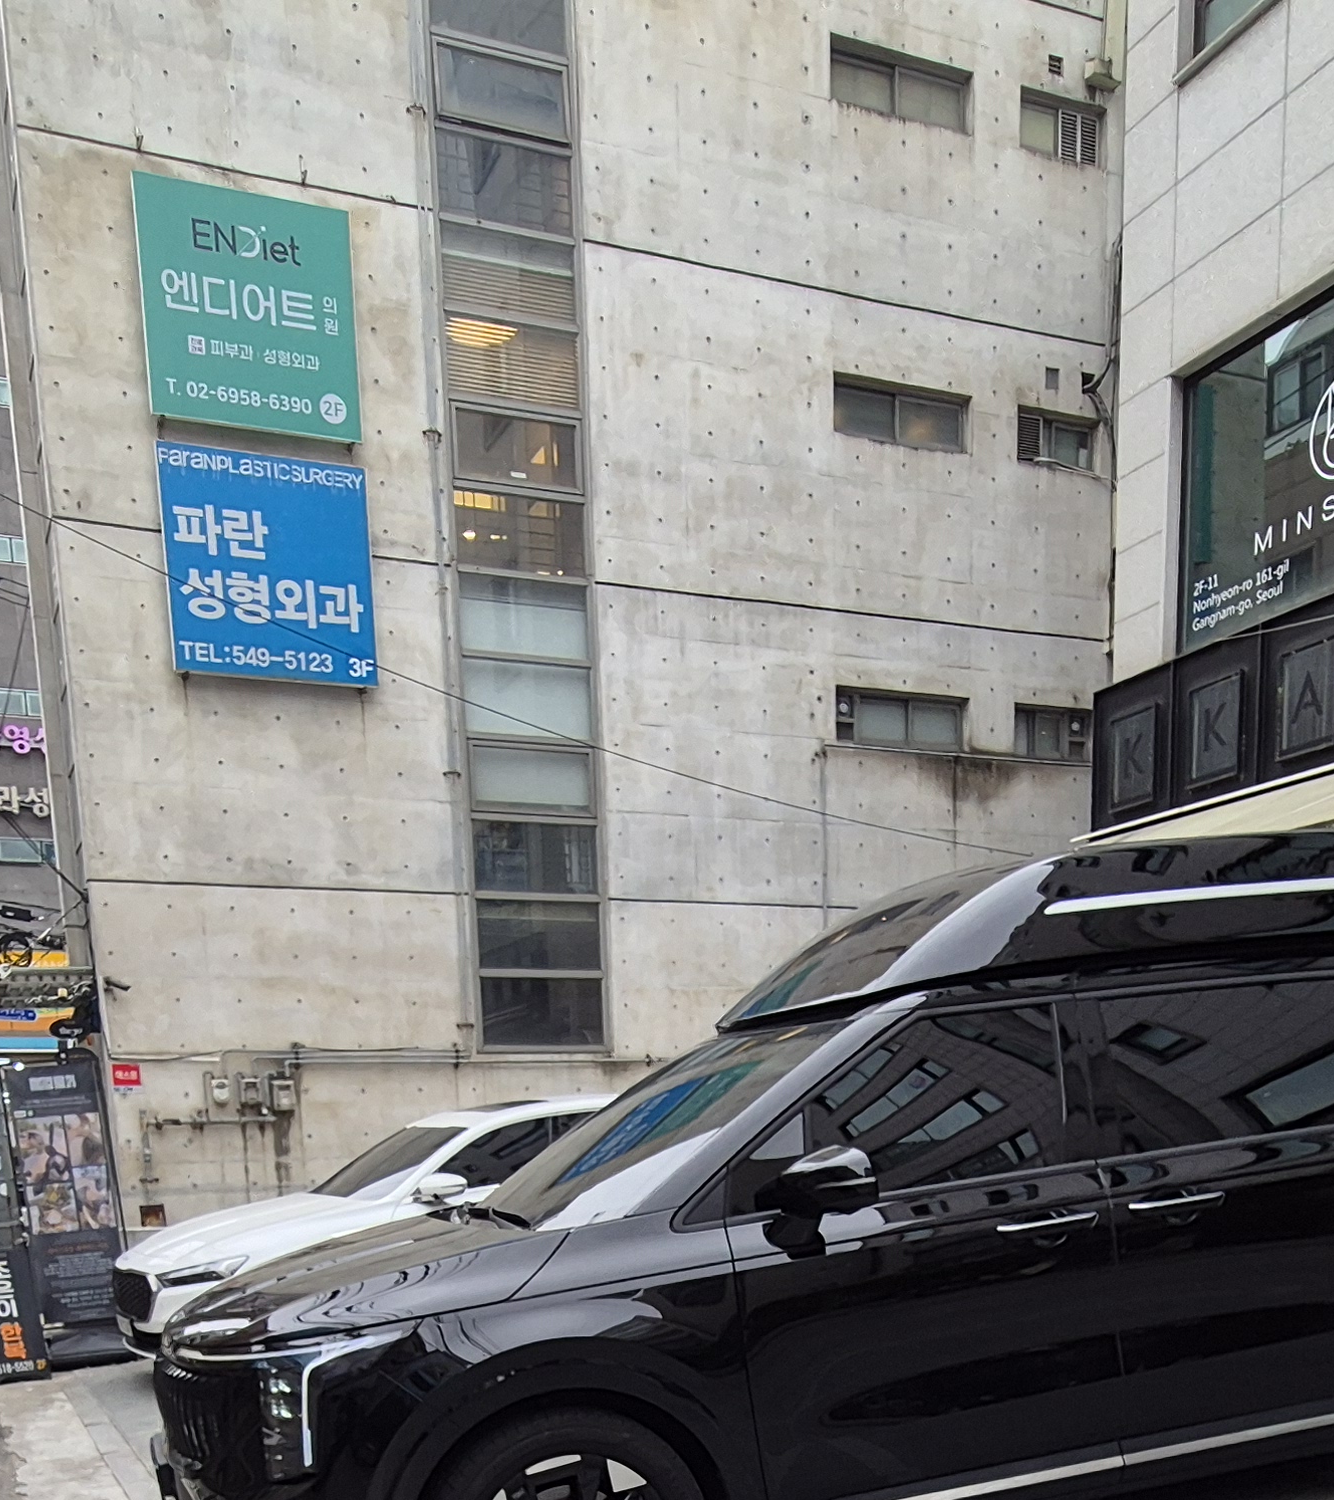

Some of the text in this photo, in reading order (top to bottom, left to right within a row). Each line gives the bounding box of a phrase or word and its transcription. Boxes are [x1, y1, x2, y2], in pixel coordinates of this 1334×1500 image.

[190, 217, 302, 267] ENDiet
[160, 268, 317, 331] 엔디어트
[322, 295, 339, 336] 의원
[209, 339, 320, 372] 피부과 성형외과
[186, 381, 312, 415] 02-6958-6390
[322, 400, 344, 418] 2F
[171, 504, 269, 561] 파란
[179, 567, 365, 634] 성형외과
[1192, 573, 1219, 597] 2F-11
[1192, 558, 1290, 614] Nonhyeon-ro 161-gil
[1255, 580, 1284, 604] Seoul
[348, 657, 374, 678] 3F
